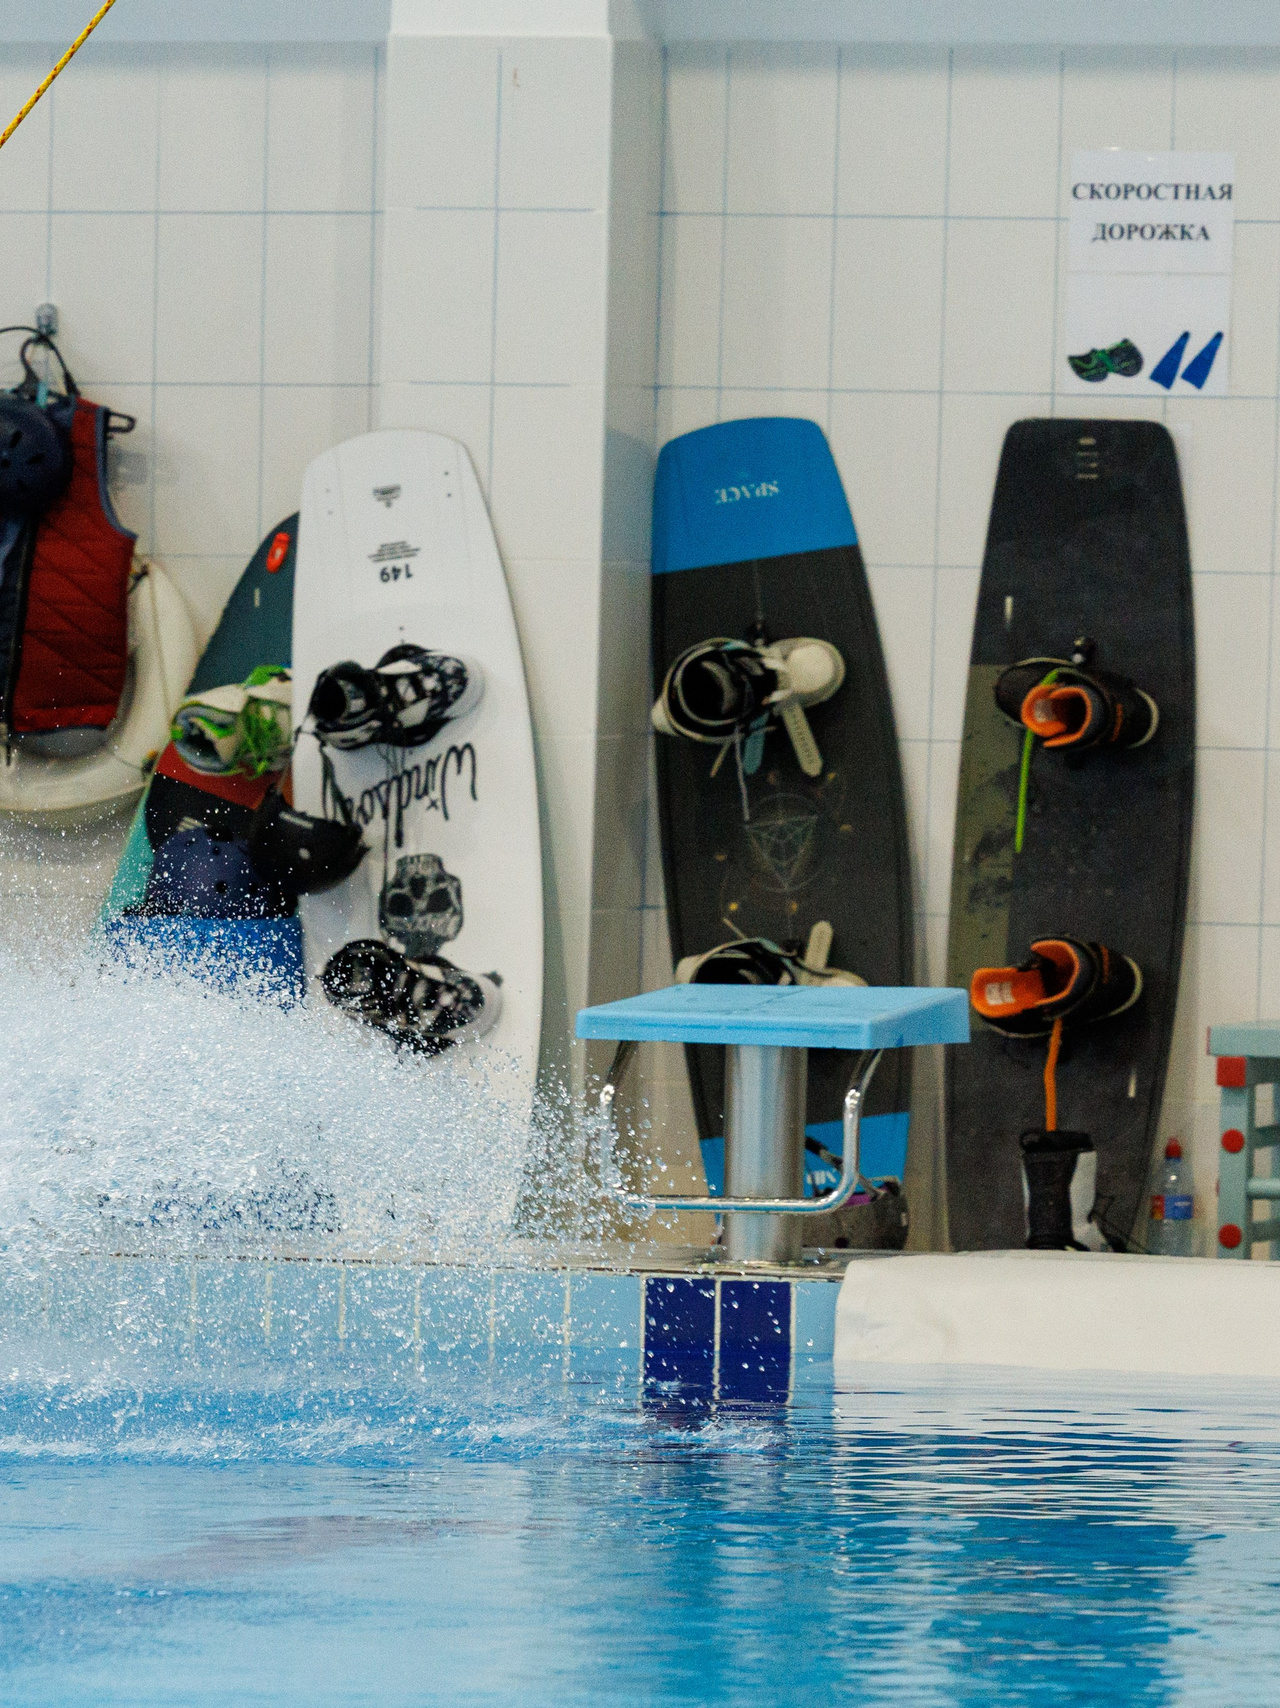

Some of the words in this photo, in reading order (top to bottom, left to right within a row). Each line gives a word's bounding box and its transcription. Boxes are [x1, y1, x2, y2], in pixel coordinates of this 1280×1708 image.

[1071, 183, 1234, 201] СКОРОСТНАЯ
[1091, 222, 1211, 243] ДОРОЖКА
[379, 563, 413, 583] 149
